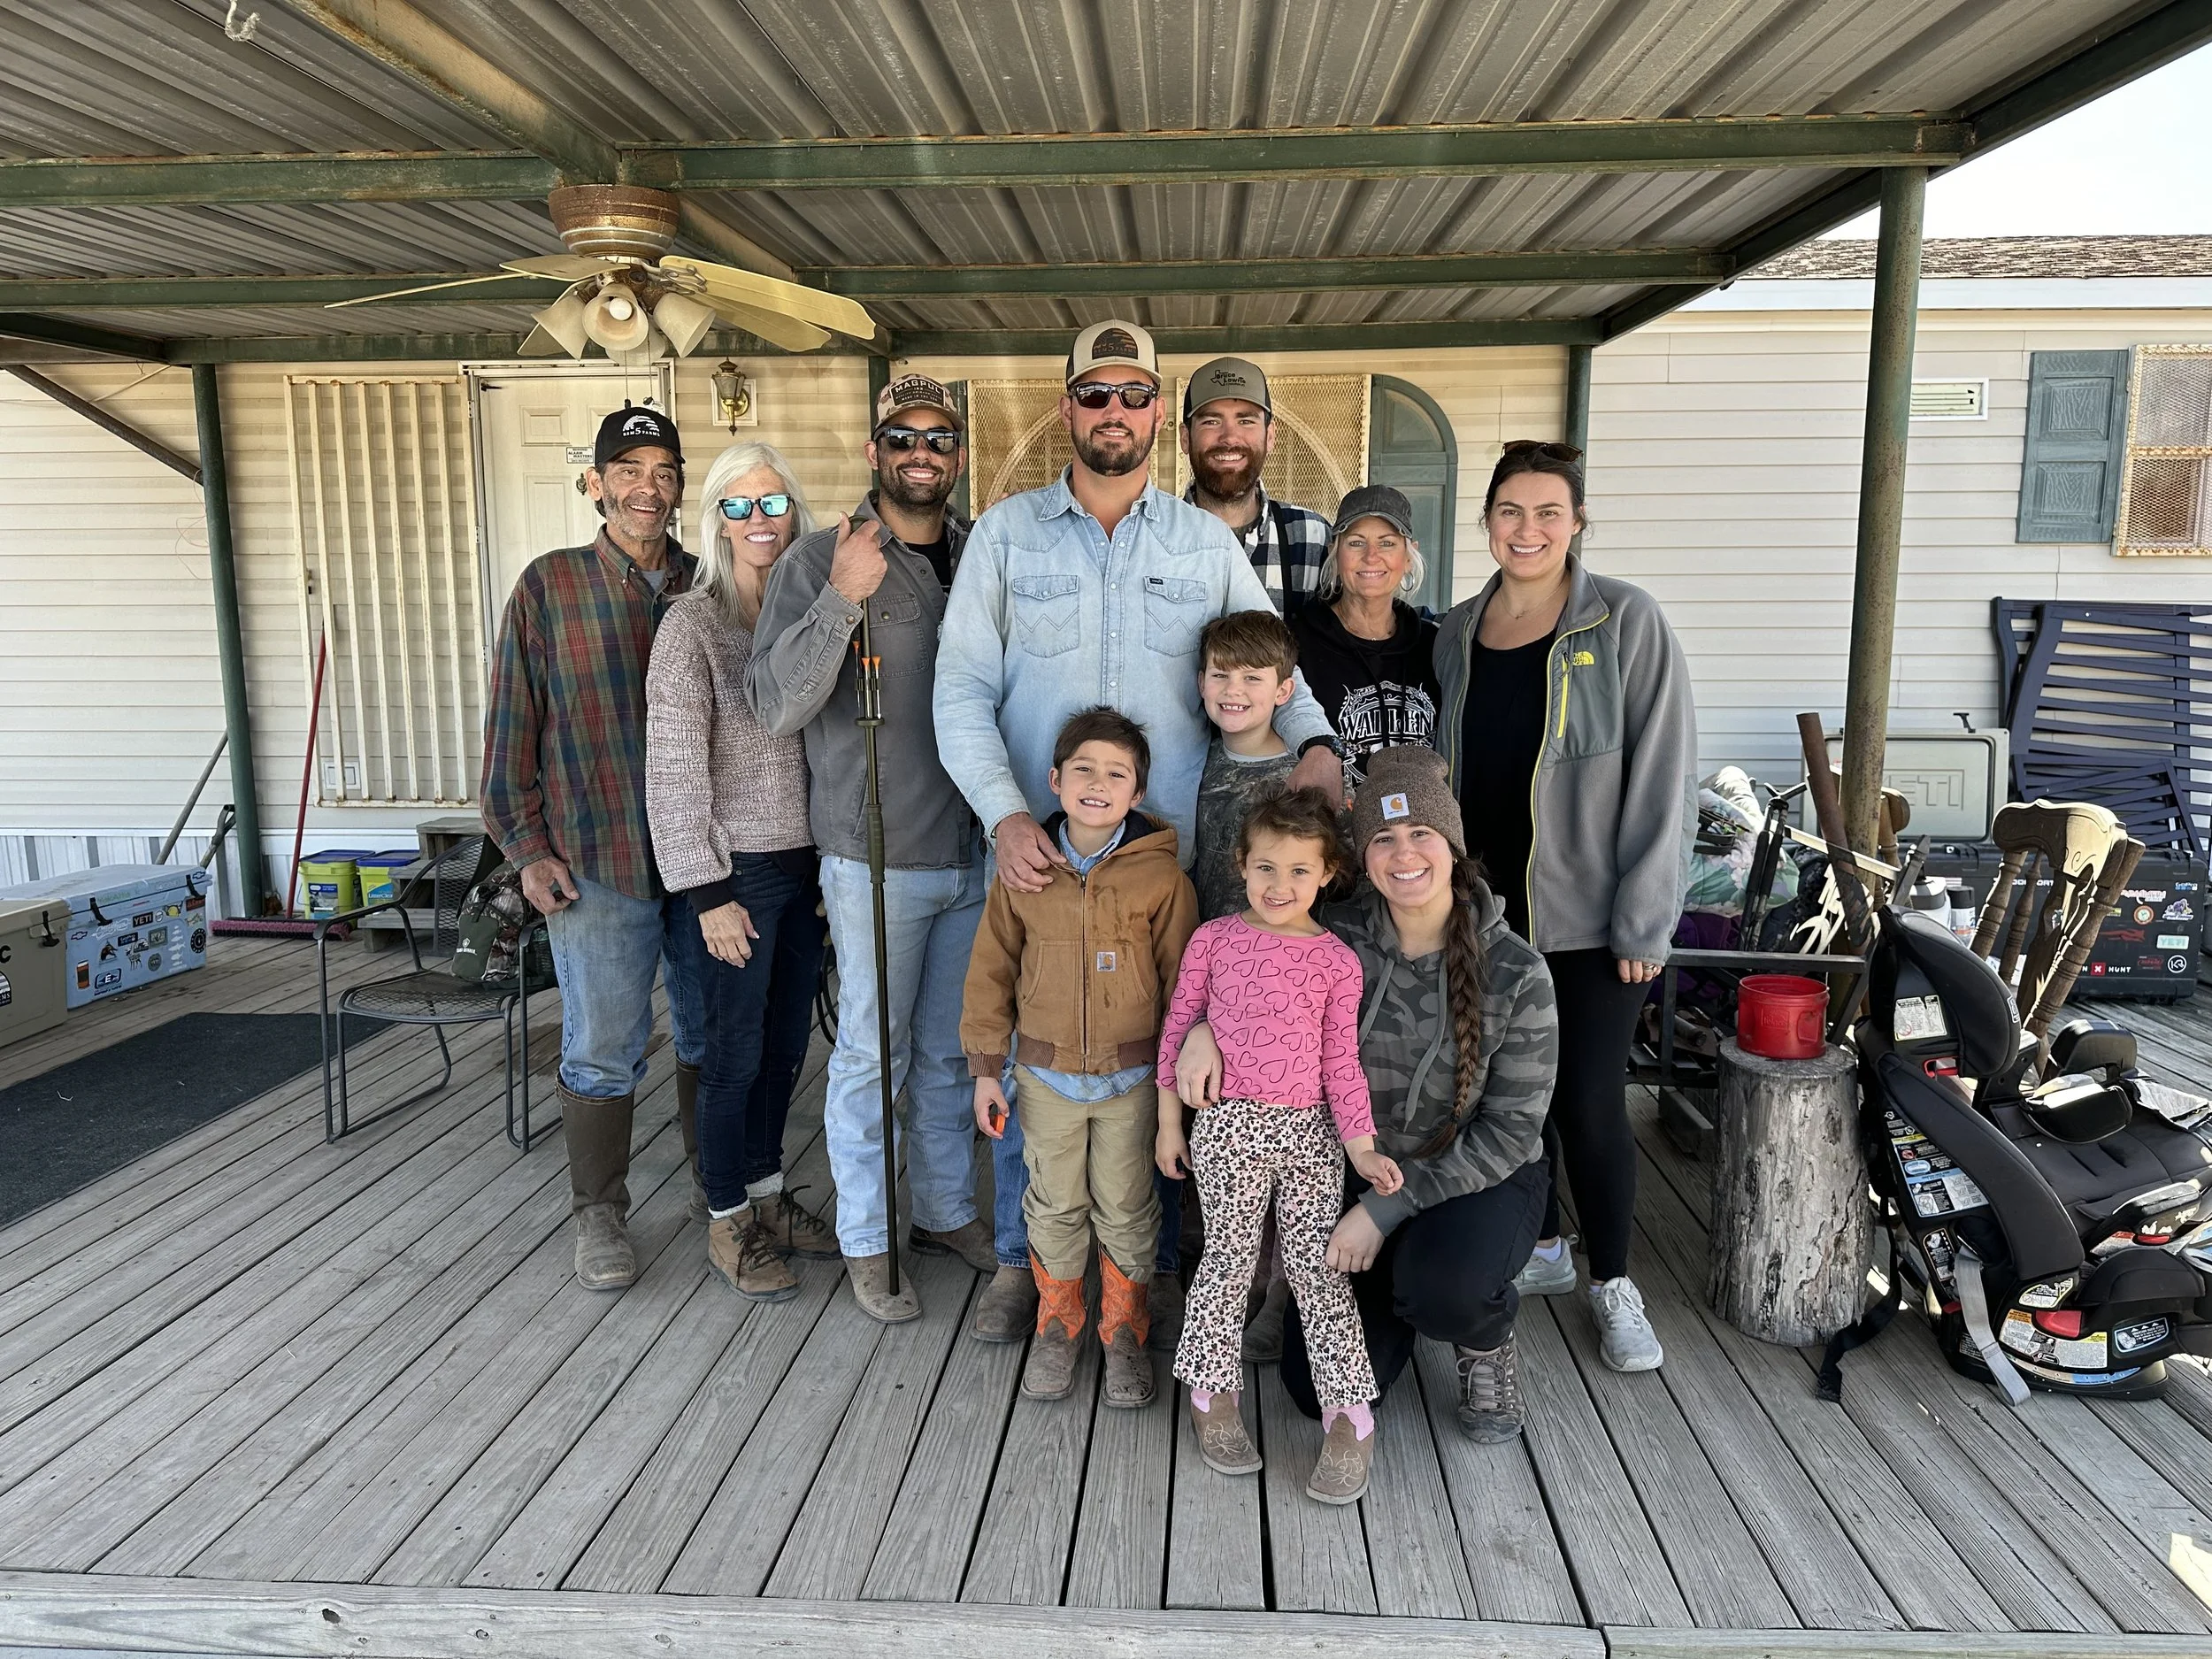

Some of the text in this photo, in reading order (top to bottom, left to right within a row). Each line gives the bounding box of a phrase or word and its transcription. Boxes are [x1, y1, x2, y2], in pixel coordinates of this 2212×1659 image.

[1108, 342, 1115, 352] 5
[895, 380, 941, 395] MAGPUL
[634, 426, 641, 435] 5
[1340, 709, 1434, 741] WALLEN
[134, 913, 152, 926] YETI
[2160, 938, 2186, 947] YETI
